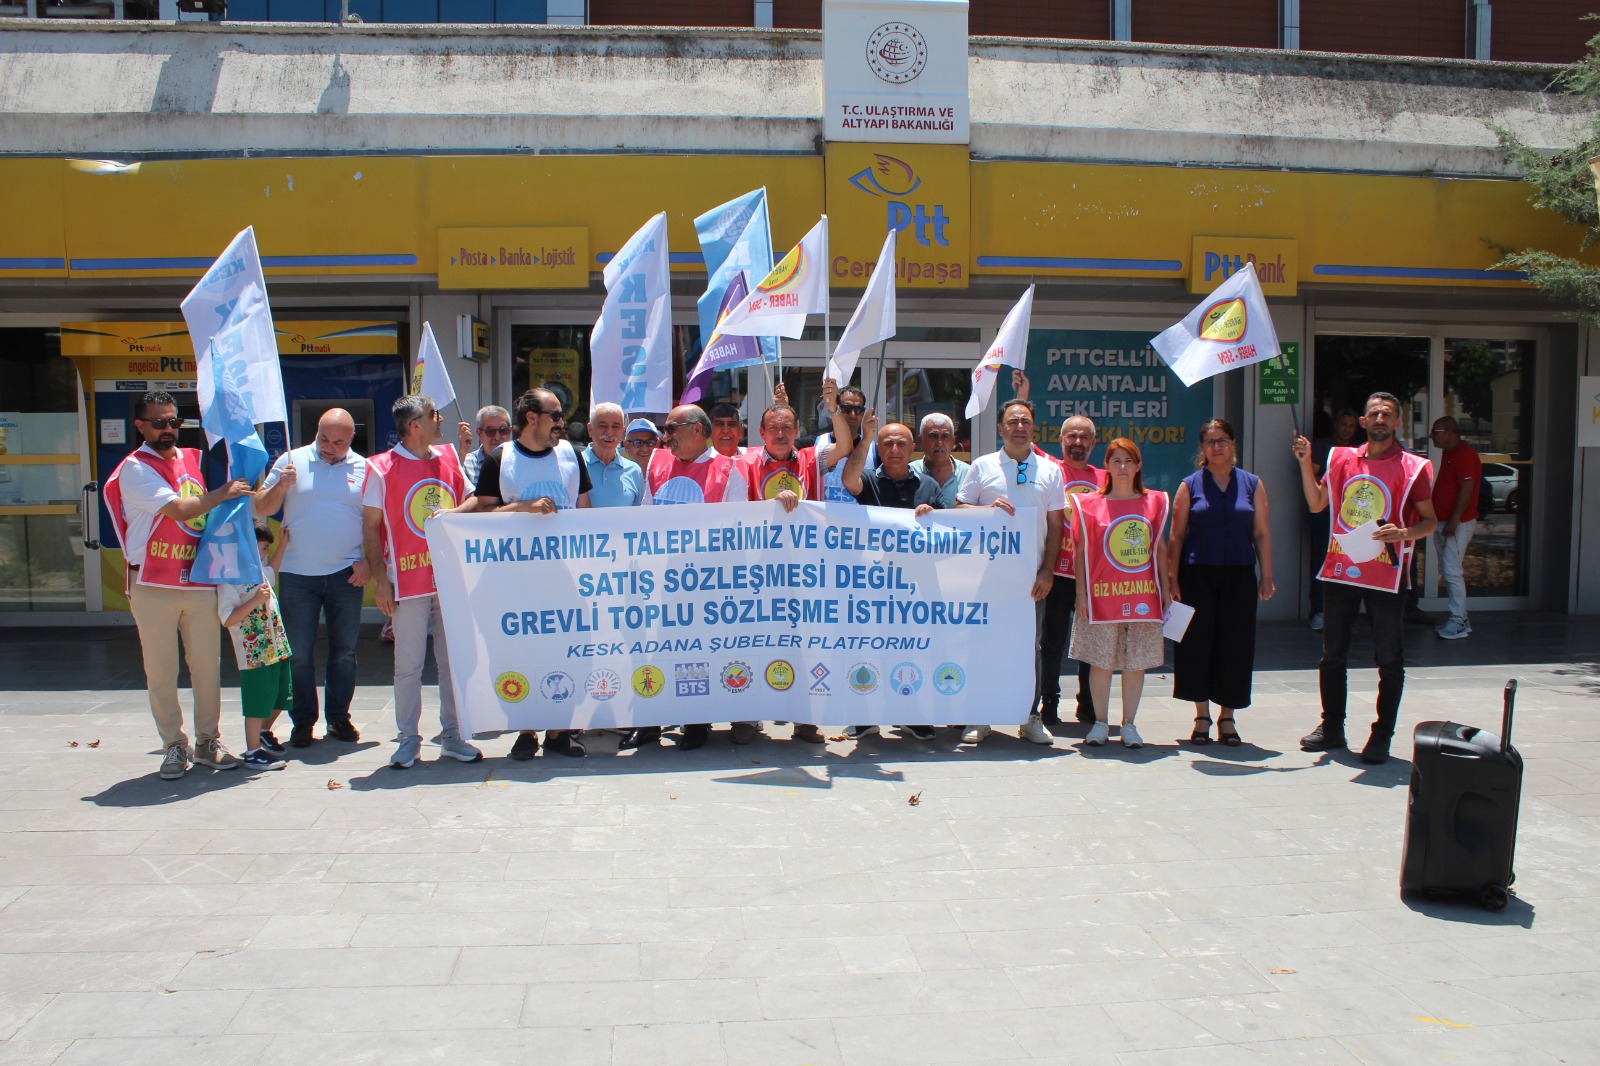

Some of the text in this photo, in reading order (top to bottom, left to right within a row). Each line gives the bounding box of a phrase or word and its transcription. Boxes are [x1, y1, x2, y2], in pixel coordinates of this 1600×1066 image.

[842, 105, 954, 119] T.C. ULAŞTIRMA VE
[842, 118, 954, 130] ALTYAPI BAKANLIĞI
[887, 201, 950, 247] Ptt
[460, 247, 575, 269] Posta Banka Lojistik
[832, 256, 962, 284] Celpaşa
[128, 359, 160, 375] engelsiz
[1047, 374, 1166, 393] AVANTAJLI
[1046, 396, 1168, 418] TEKLİFLERİ
[150, 538, 168, 558] BİZ
[465, 520, 1021, 563] HAKLARIMIZ, TALEPLERİMİZ VE GELECEĞİMİZ İÇİN
[400, 552, 417, 571] BİZ
[578, 558, 916, 600] SATIŞ SÖZLEŞMESİ DEĞİL,
[1094, 580, 1110, 597] BİZ
[501, 594, 988, 636] GREVLİ TOPLU SÖZLEŞME İSTİYORUZ!
[567, 634, 930, 658] KESK ADANA ŞUBELER PLATFORMU
[678, 681, 707, 694] BTS
